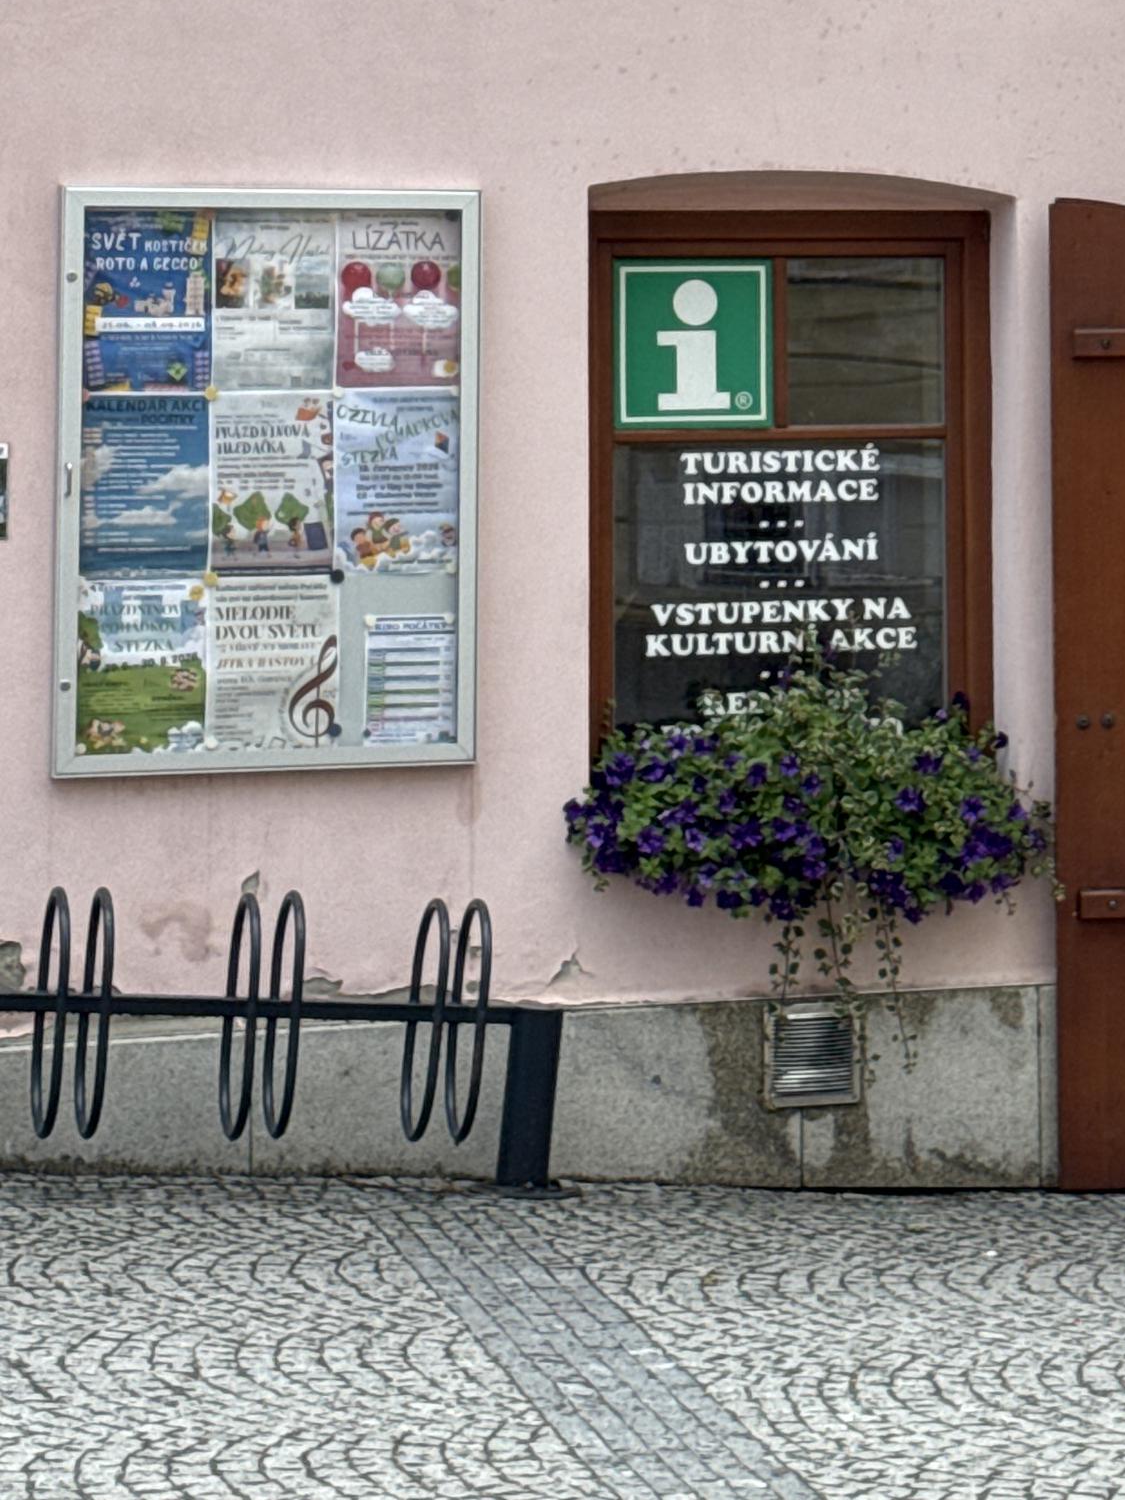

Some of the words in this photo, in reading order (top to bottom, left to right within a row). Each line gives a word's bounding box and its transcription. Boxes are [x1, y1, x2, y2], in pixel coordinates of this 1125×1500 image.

[91, 228, 142, 251] SVĚT
[352, 223, 445, 251] LÍZÁTKA
[96, 257, 135, 271] ROTO
[140, 257, 148, 270] A
[680, 443, 880, 475] TURISTICKÉ
[683, 478, 879, 505] INFORMACE
[684, 532, 879, 565] UBYTOVÁNÍ
[215, 606, 295, 621] MELODIE
[651, 598, 854, 626] VSTUPENKY
[862, 597, 911, 620] NA
[215, 625, 265, 640] DVOU
[830, 626, 918, 651] AKCE
